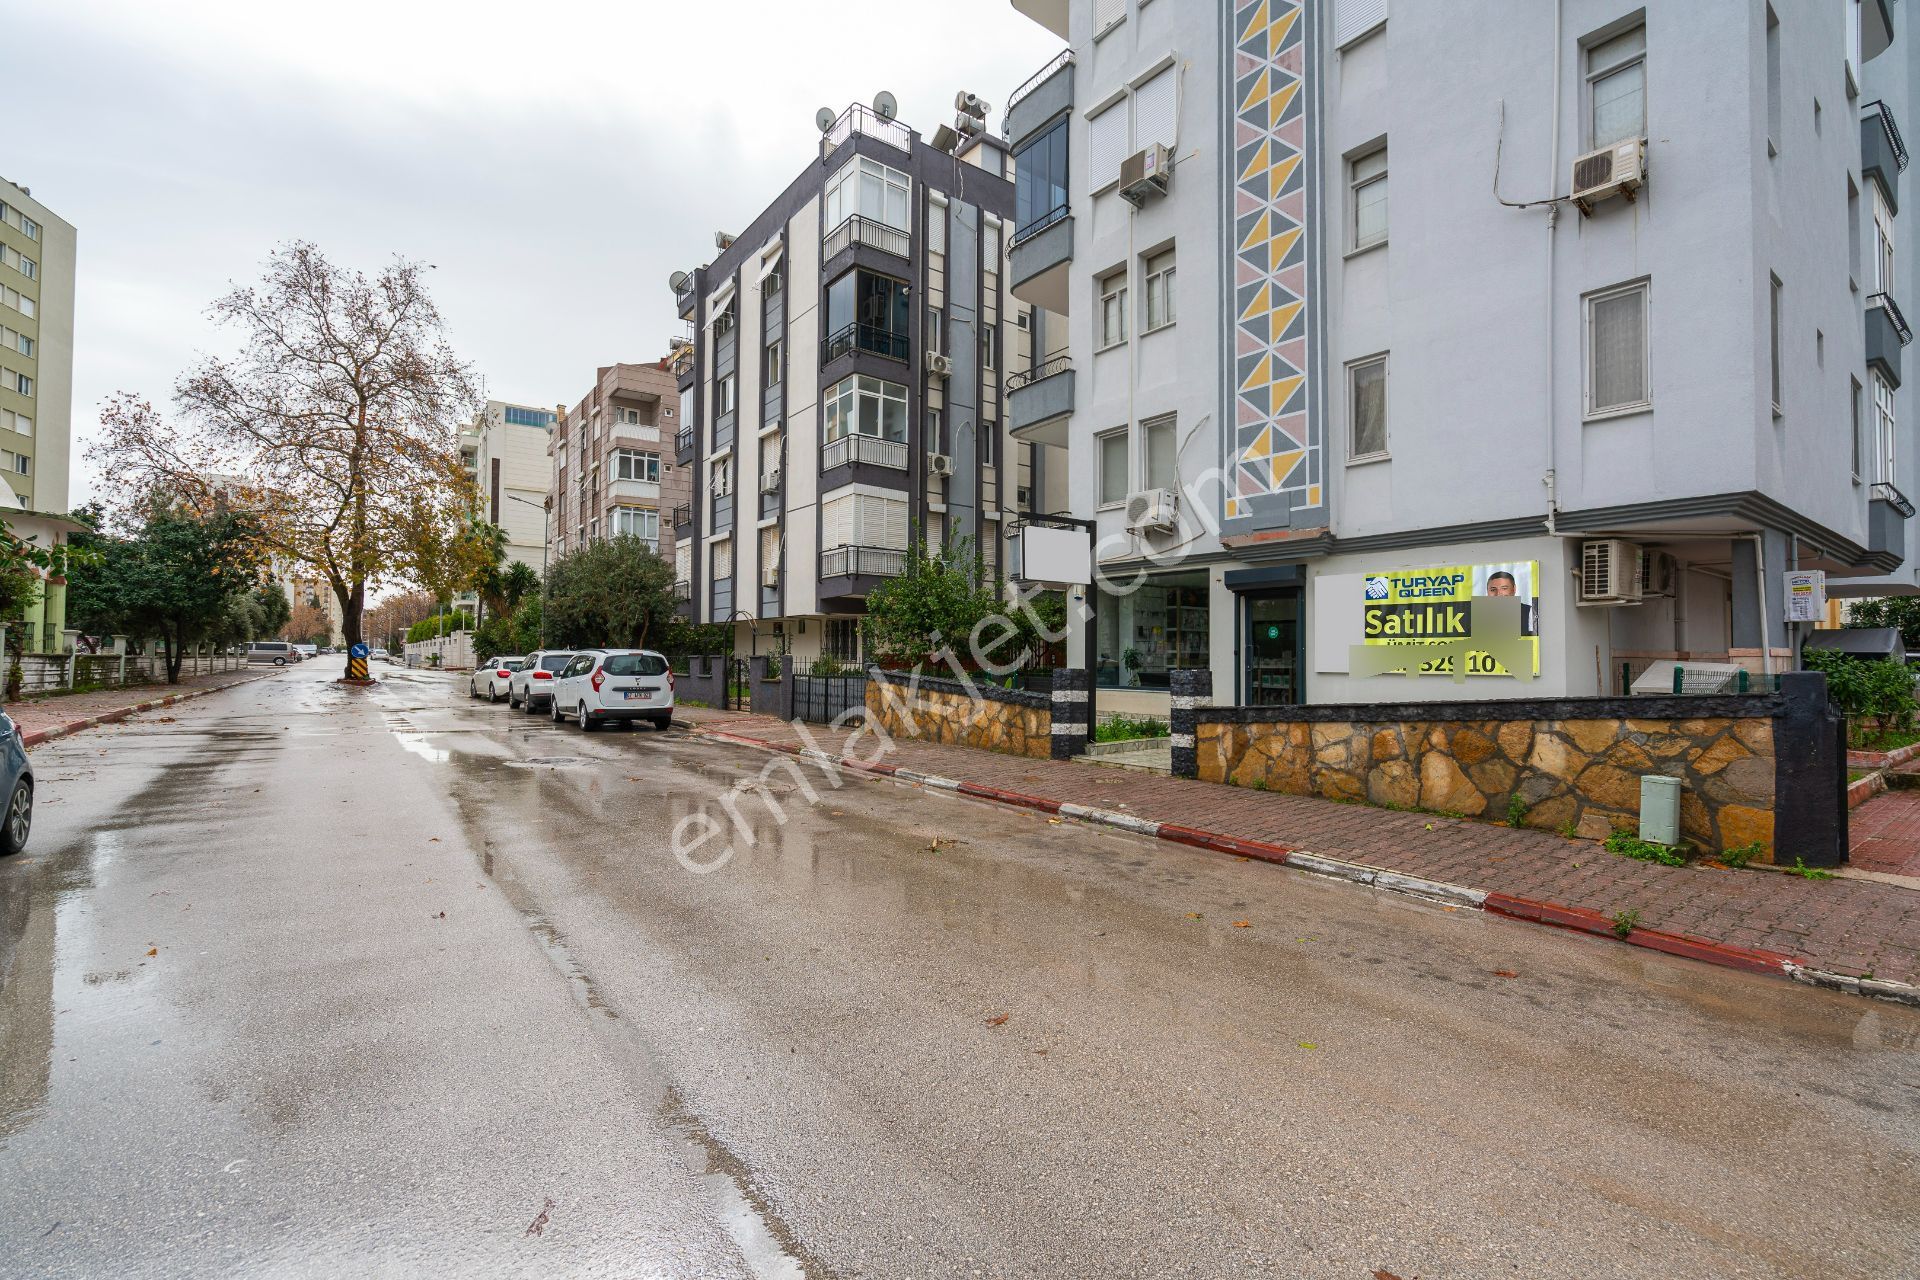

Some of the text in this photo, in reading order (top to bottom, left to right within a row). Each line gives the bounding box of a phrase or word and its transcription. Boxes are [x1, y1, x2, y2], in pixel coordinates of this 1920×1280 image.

[1390, 574, 1465, 589] TURYAP
[1399, 587, 1455, 598] QUEEN
[1365, 606, 1466, 635] Satılık
